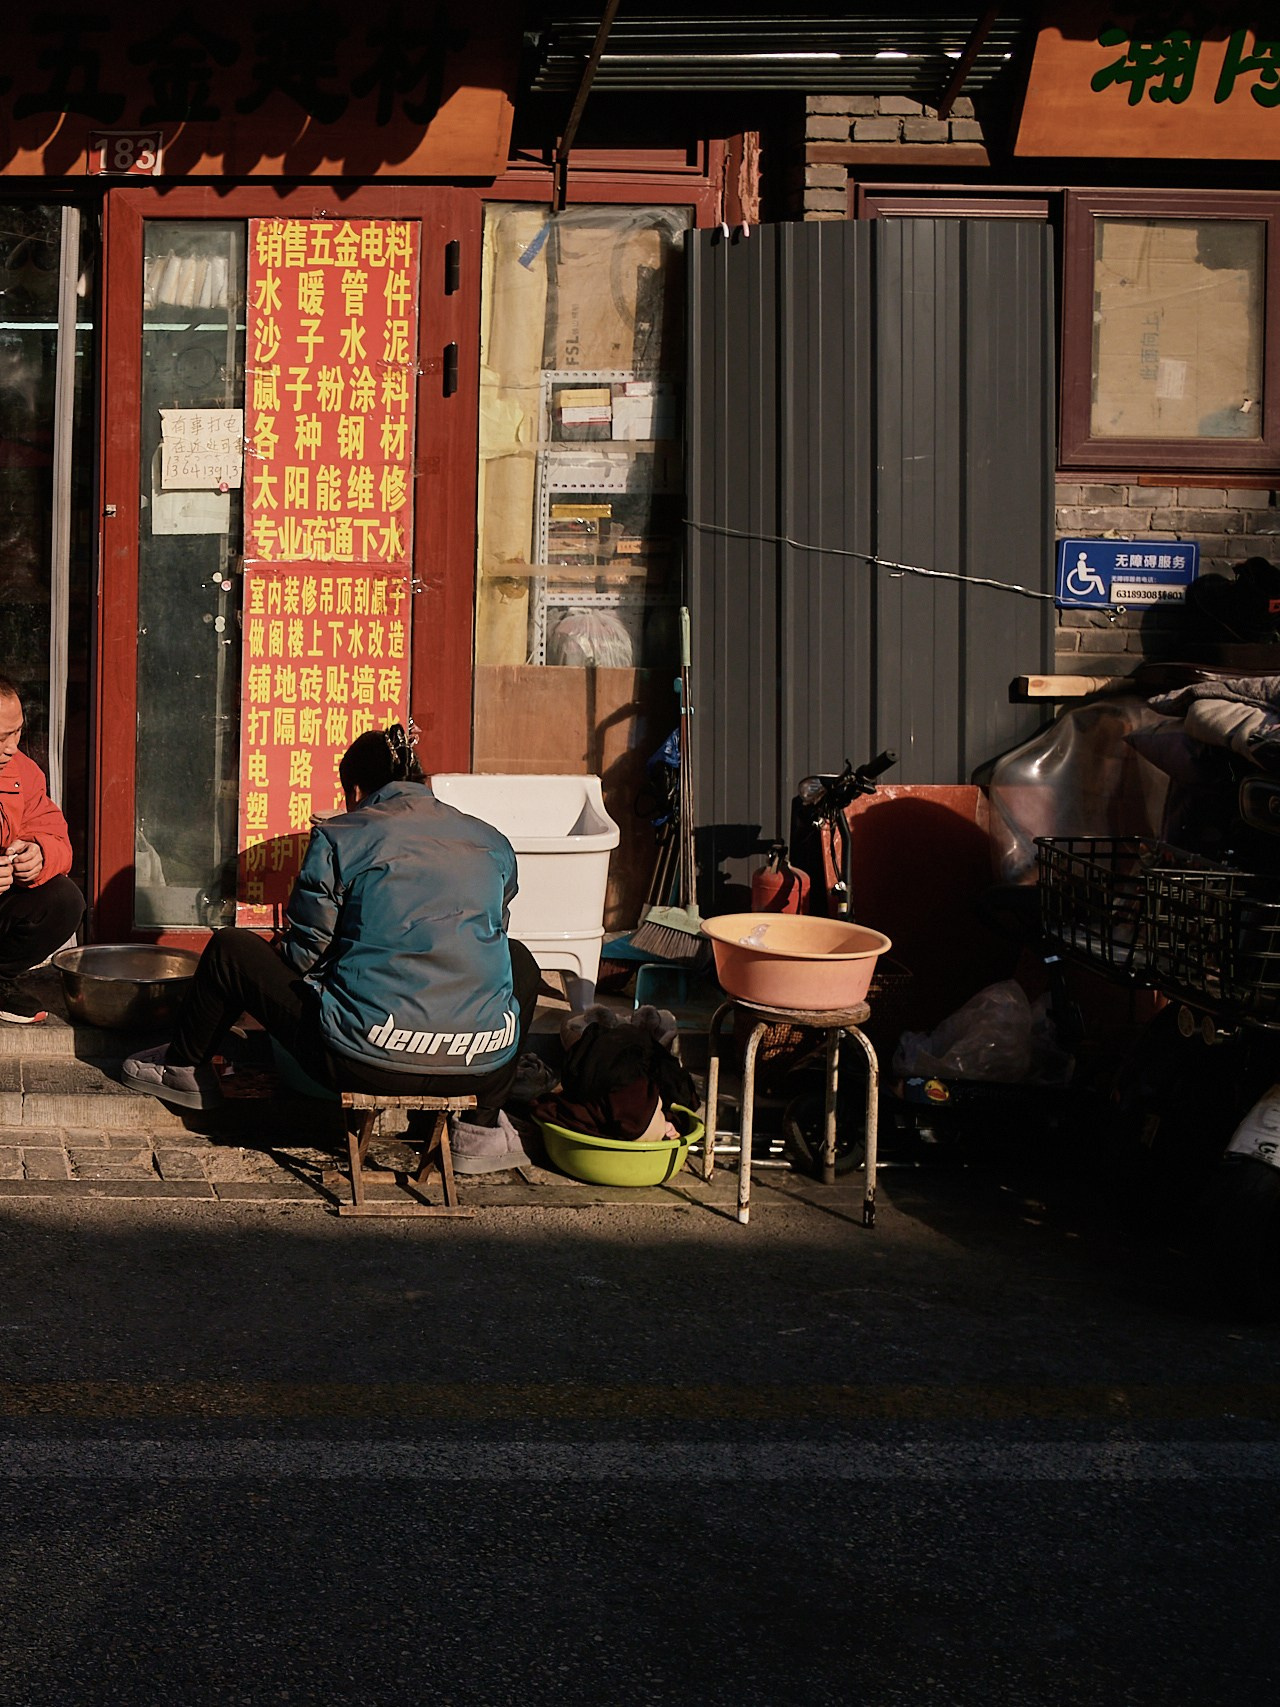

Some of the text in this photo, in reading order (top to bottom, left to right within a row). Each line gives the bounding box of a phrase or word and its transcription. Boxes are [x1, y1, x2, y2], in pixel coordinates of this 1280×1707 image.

[95, 138, 156, 169] 183
[256, 221, 412, 268] 销售五金电料
[256, 269, 411, 316] 水暖管件
[254, 318, 409, 364] 沙子水泥
[566, 336, 579, 365] FSL
[253, 365, 409, 412] 腻子粉涂料
[253, 413, 408, 460] 各种钢材
[252, 464, 407, 512] 太阳能维修
[252, 516, 405, 562] 专业疏通下水
[1115, 553, 1186, 569] 无障碍服务
[249, 576, 406, 616] 室内装修吊顶刮腻子
[248, 618, 405, 659] 做阁楼上下水改造
[248, 664, 402, 705] 铺地砖贴墙砖
[246, 792, 346, 831] 塑钢
[366, 1010, 516, 1066] denrepall
